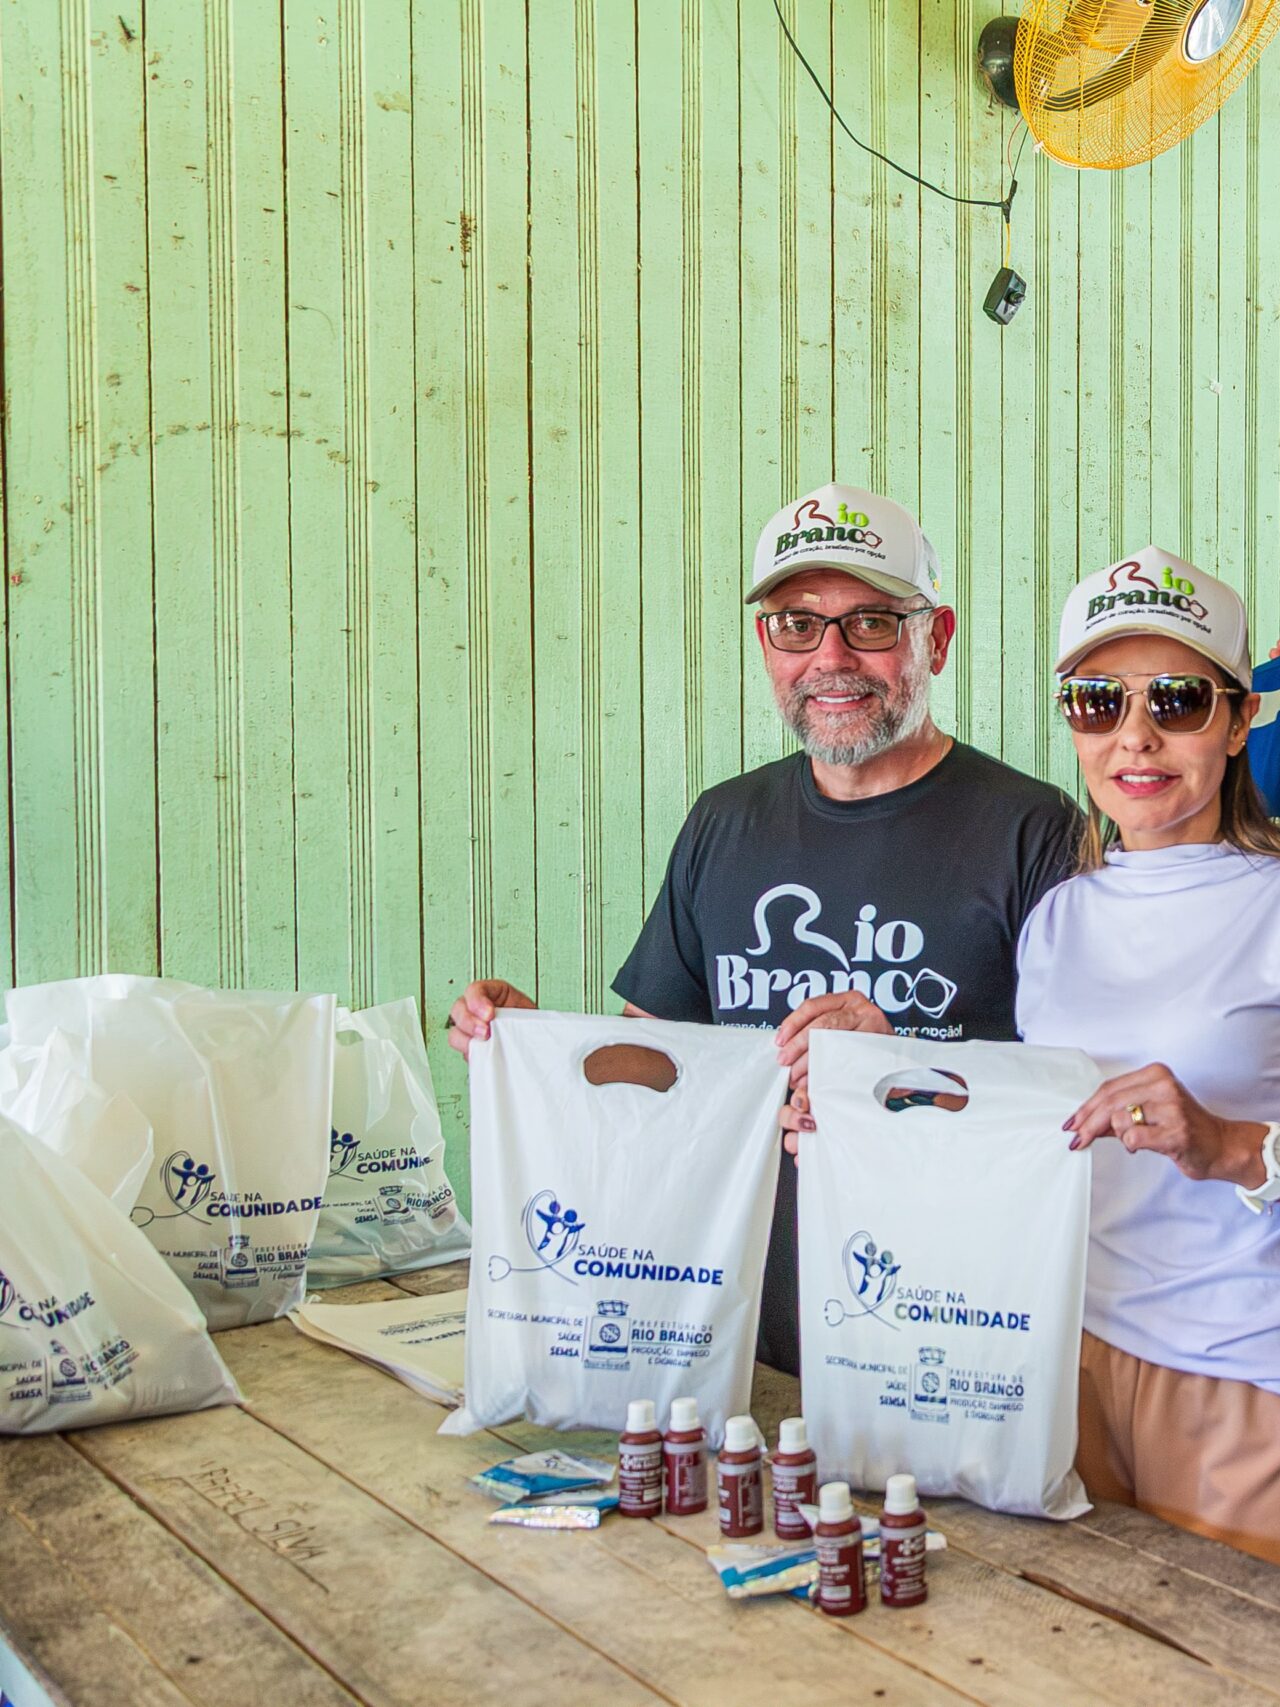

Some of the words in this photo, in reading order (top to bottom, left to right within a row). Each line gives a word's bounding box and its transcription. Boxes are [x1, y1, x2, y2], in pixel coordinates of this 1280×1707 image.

[358, 1148, 396, 1161] SAÚDE
[400, 1146, 416, 1156] NA
[244, 1192, 262, 1201] NA
[256, 1253, 276, 1264] RIO
[578, 1243, 627, 1260] SAÚDE
[632, 1249, 655, 1261] NA
[573, 1259, 724, 1286] COMUNIDADE
[897, 1285, 941, 1302] SAÚDE
[946, 1292, 966, 1304] NA
[895, 1304, 1031, 1331] COMUNIDADE
[631, 1328, 655, 1341] RIO
[660, 1329, 713, 1345] BRANCO
[550, 1345, 580, 1357] SEMSA
[949, 1378, 970, 1392] RIO
[974, 1381, 1024, 1397] BRANCO
